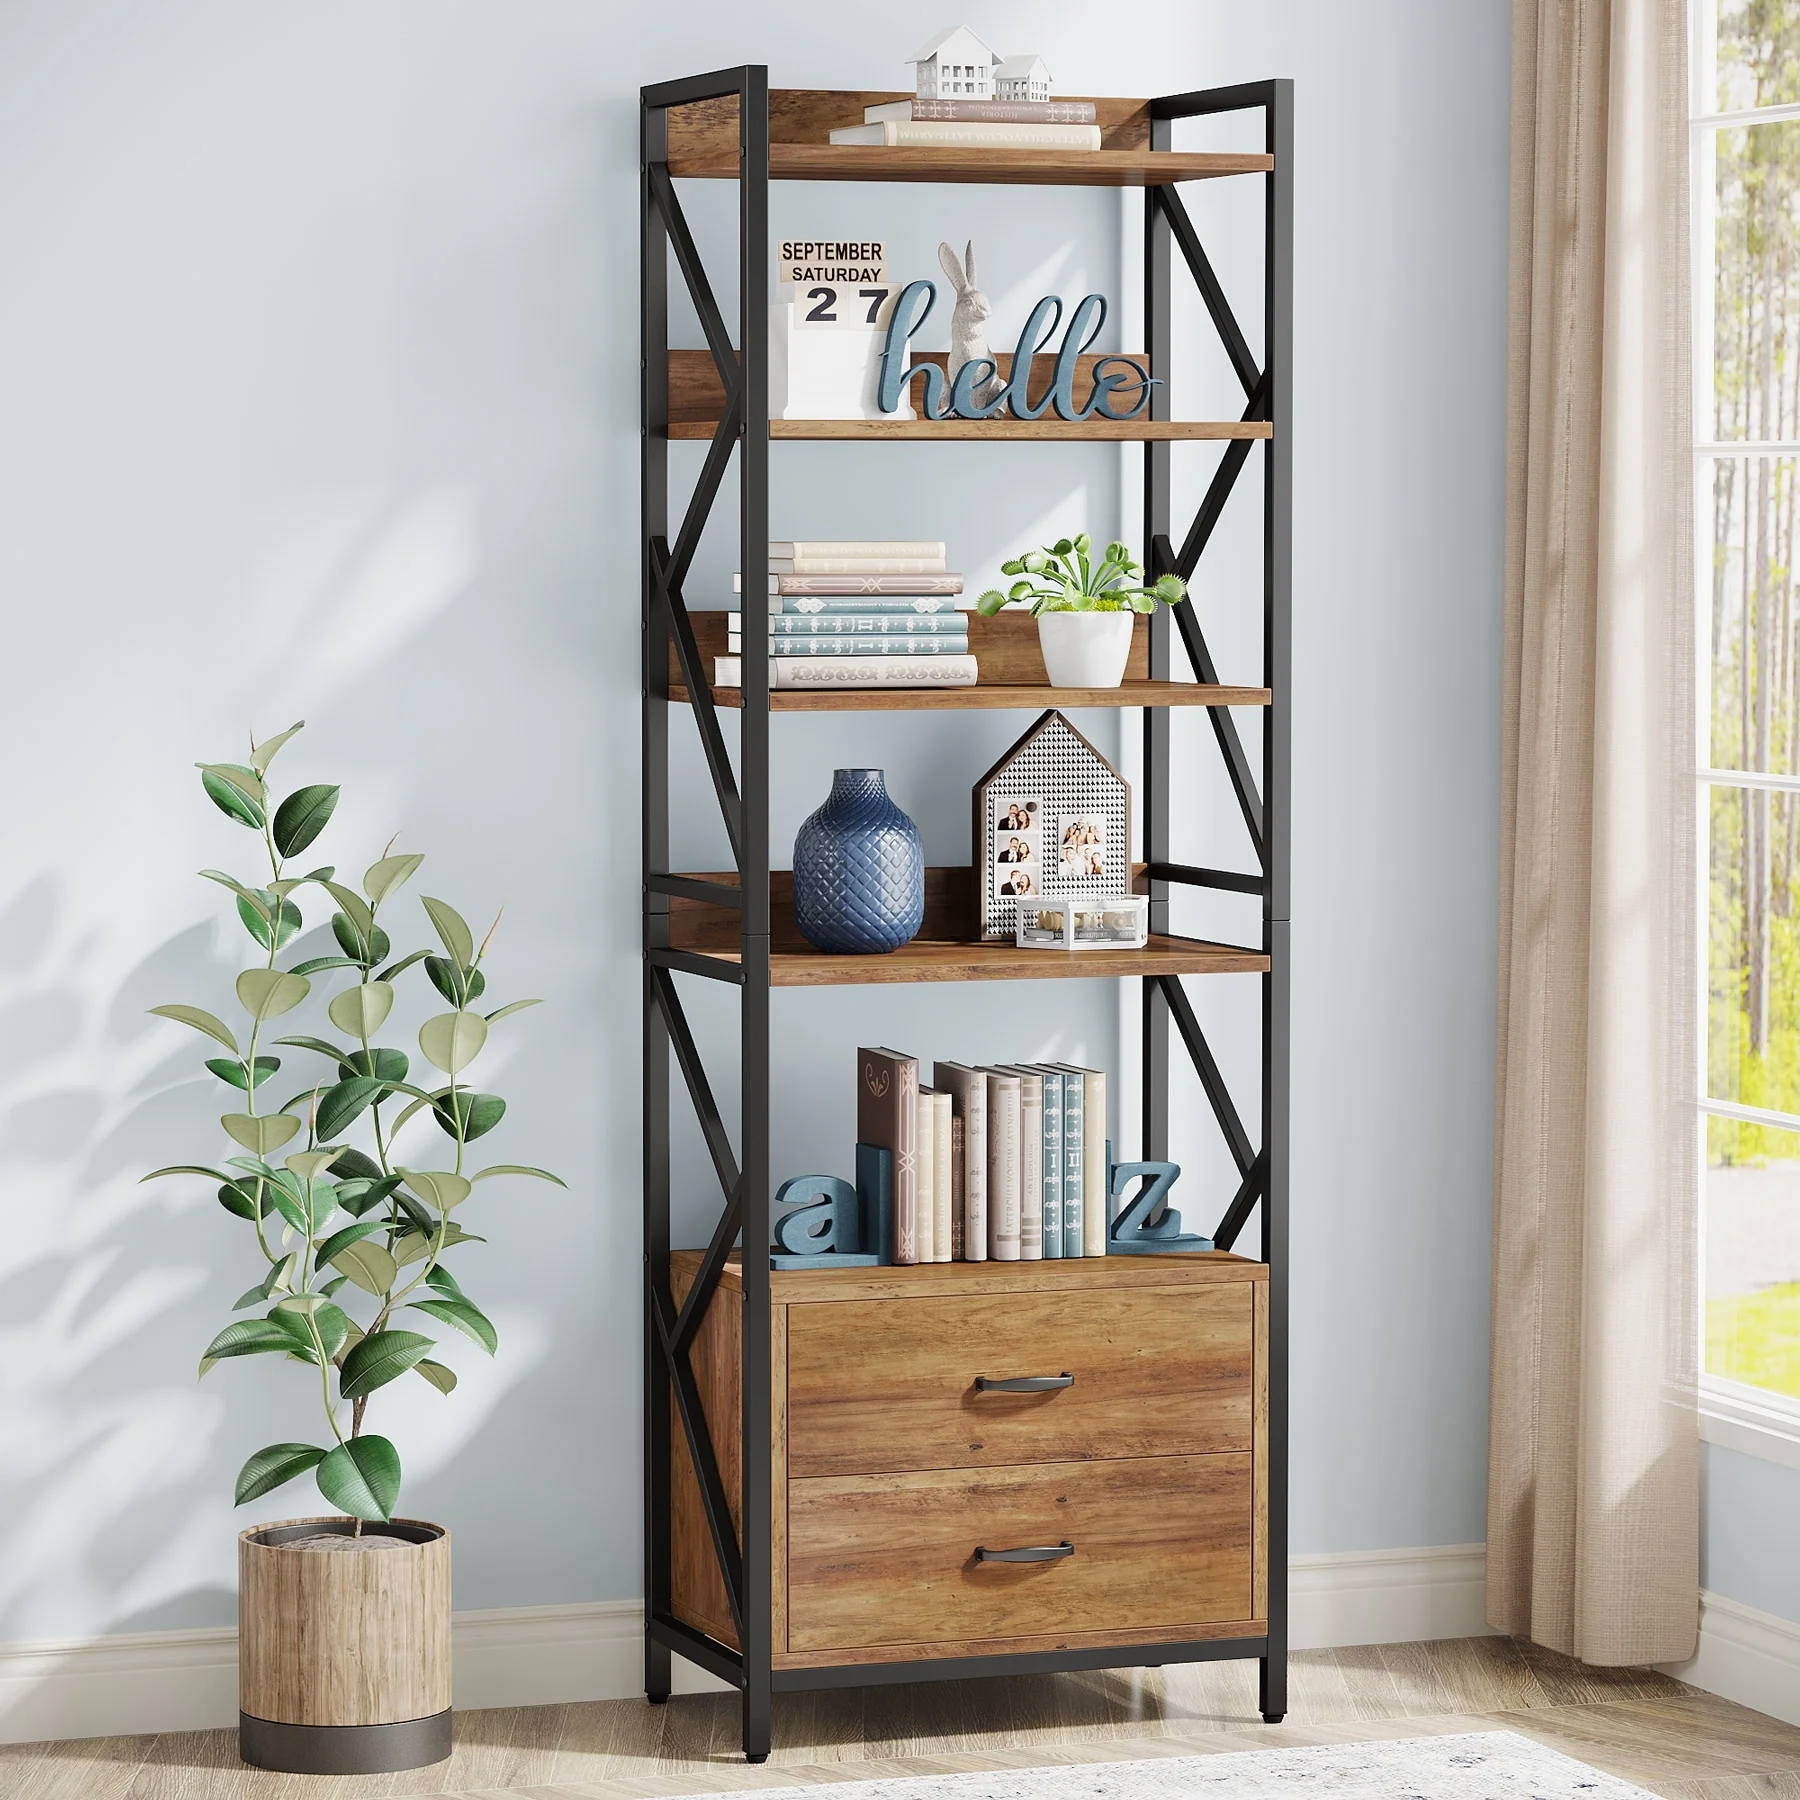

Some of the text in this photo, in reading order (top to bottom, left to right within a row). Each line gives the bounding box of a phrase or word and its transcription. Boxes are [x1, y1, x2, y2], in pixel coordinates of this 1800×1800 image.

[899, 130, 972, 141] LATINARUM
[975, 132, 1021, 143] VOCUM
[782, 242, 883, 260] SEPTEMBER
[792, 267, 882, 282] SATURDAY
[877, 279, 1164, 421] hello
[774, 1174, 859, 1255] a
